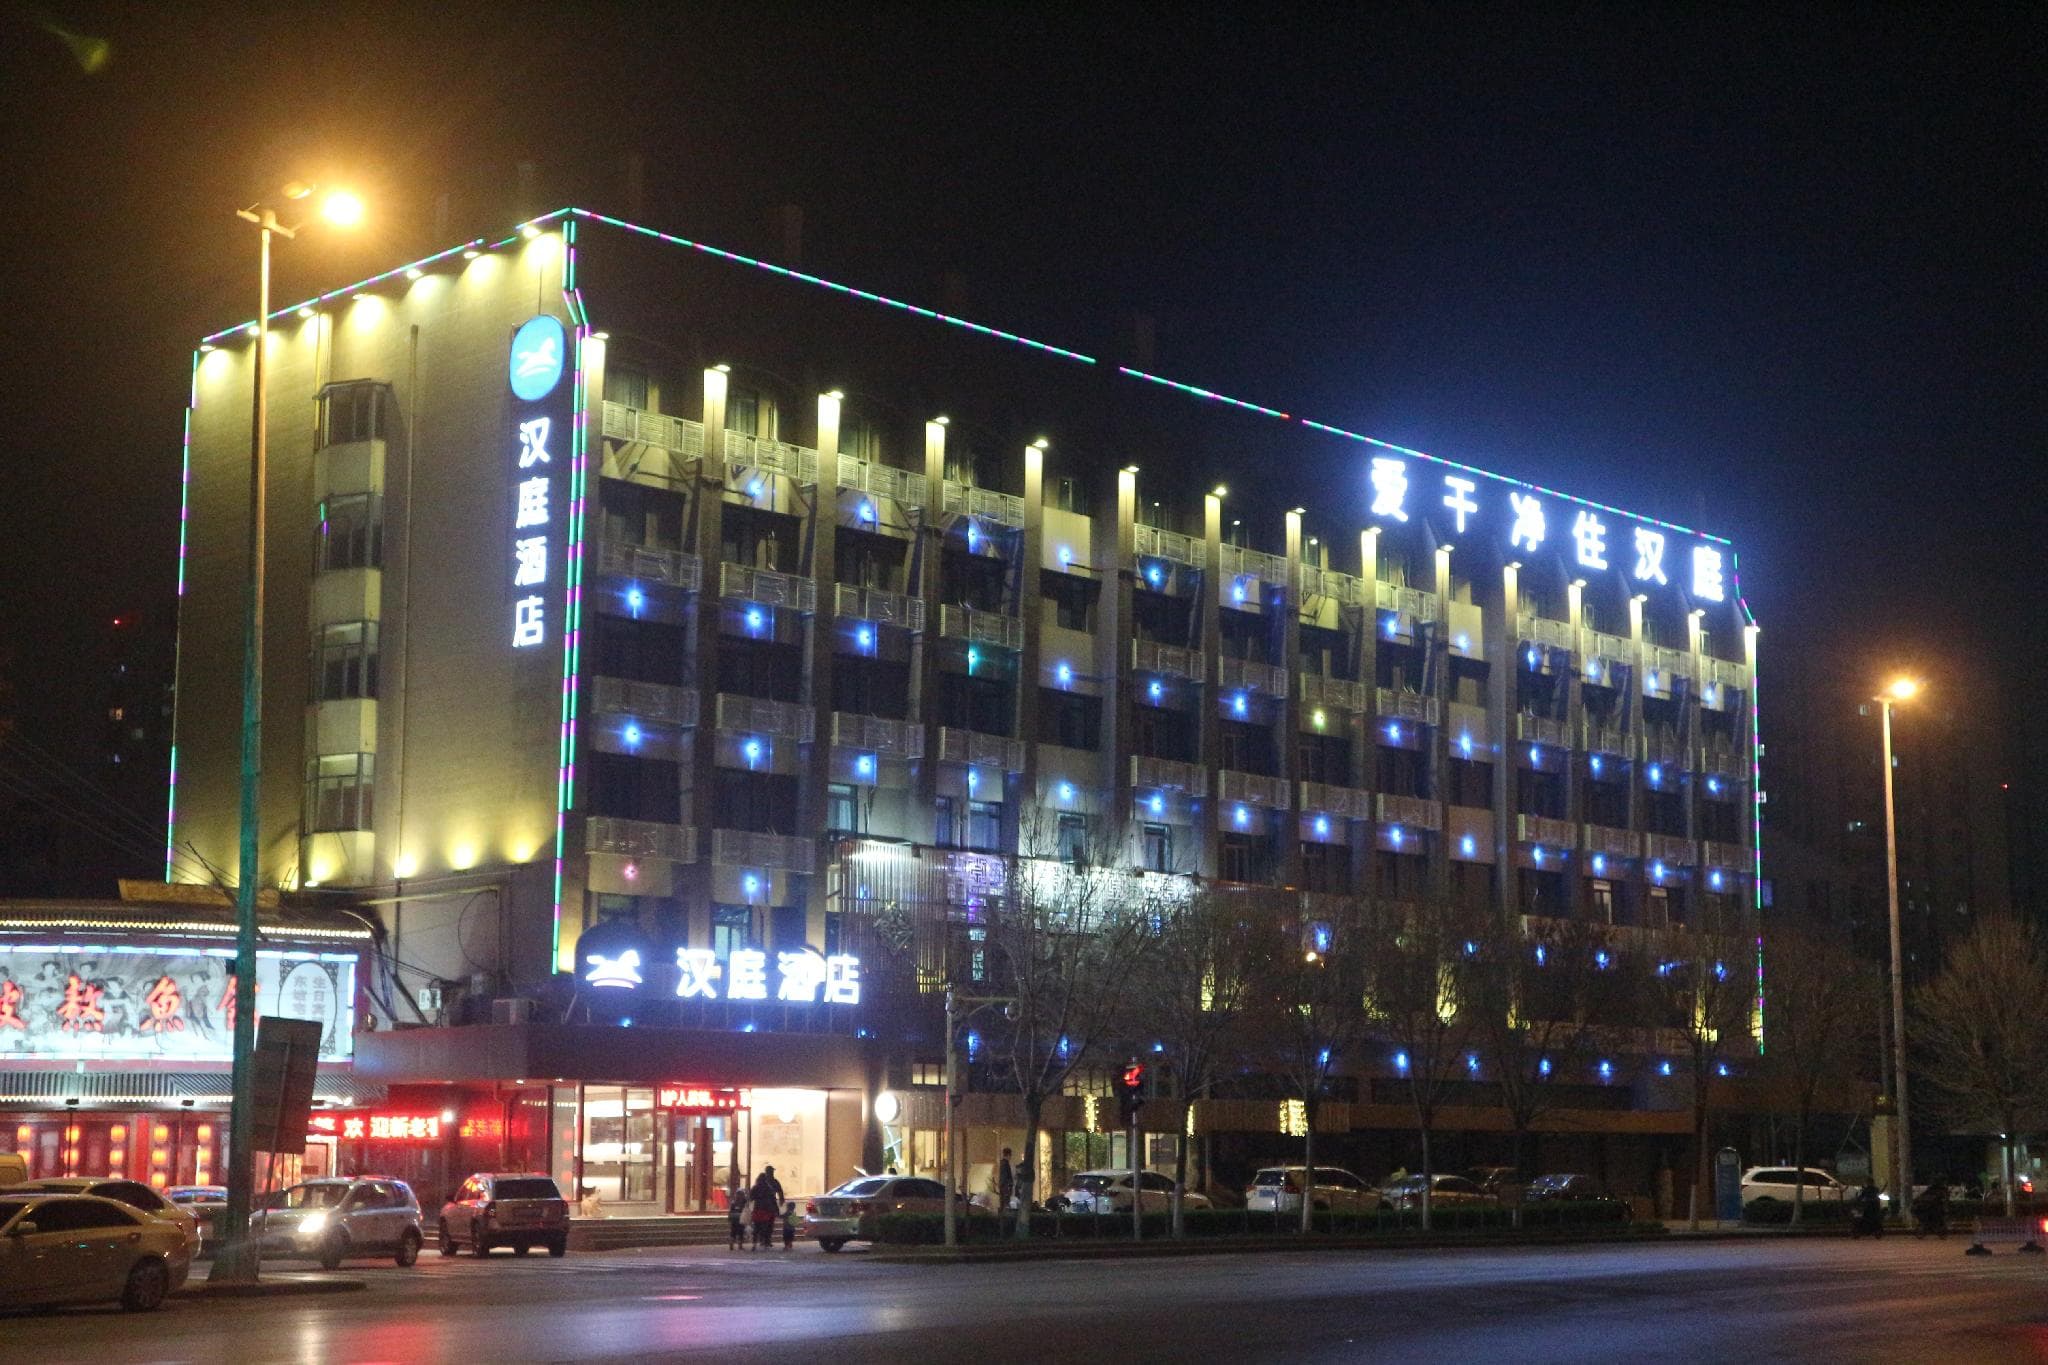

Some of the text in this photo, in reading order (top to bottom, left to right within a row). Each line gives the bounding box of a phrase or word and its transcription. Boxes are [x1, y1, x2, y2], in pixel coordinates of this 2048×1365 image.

[512, 416, 551, 648] 汉庭酒店
[1371, 457, 1724, 602] 爱干净住汉庭
[676, 947, 861, 1005] 汉庭酒店
